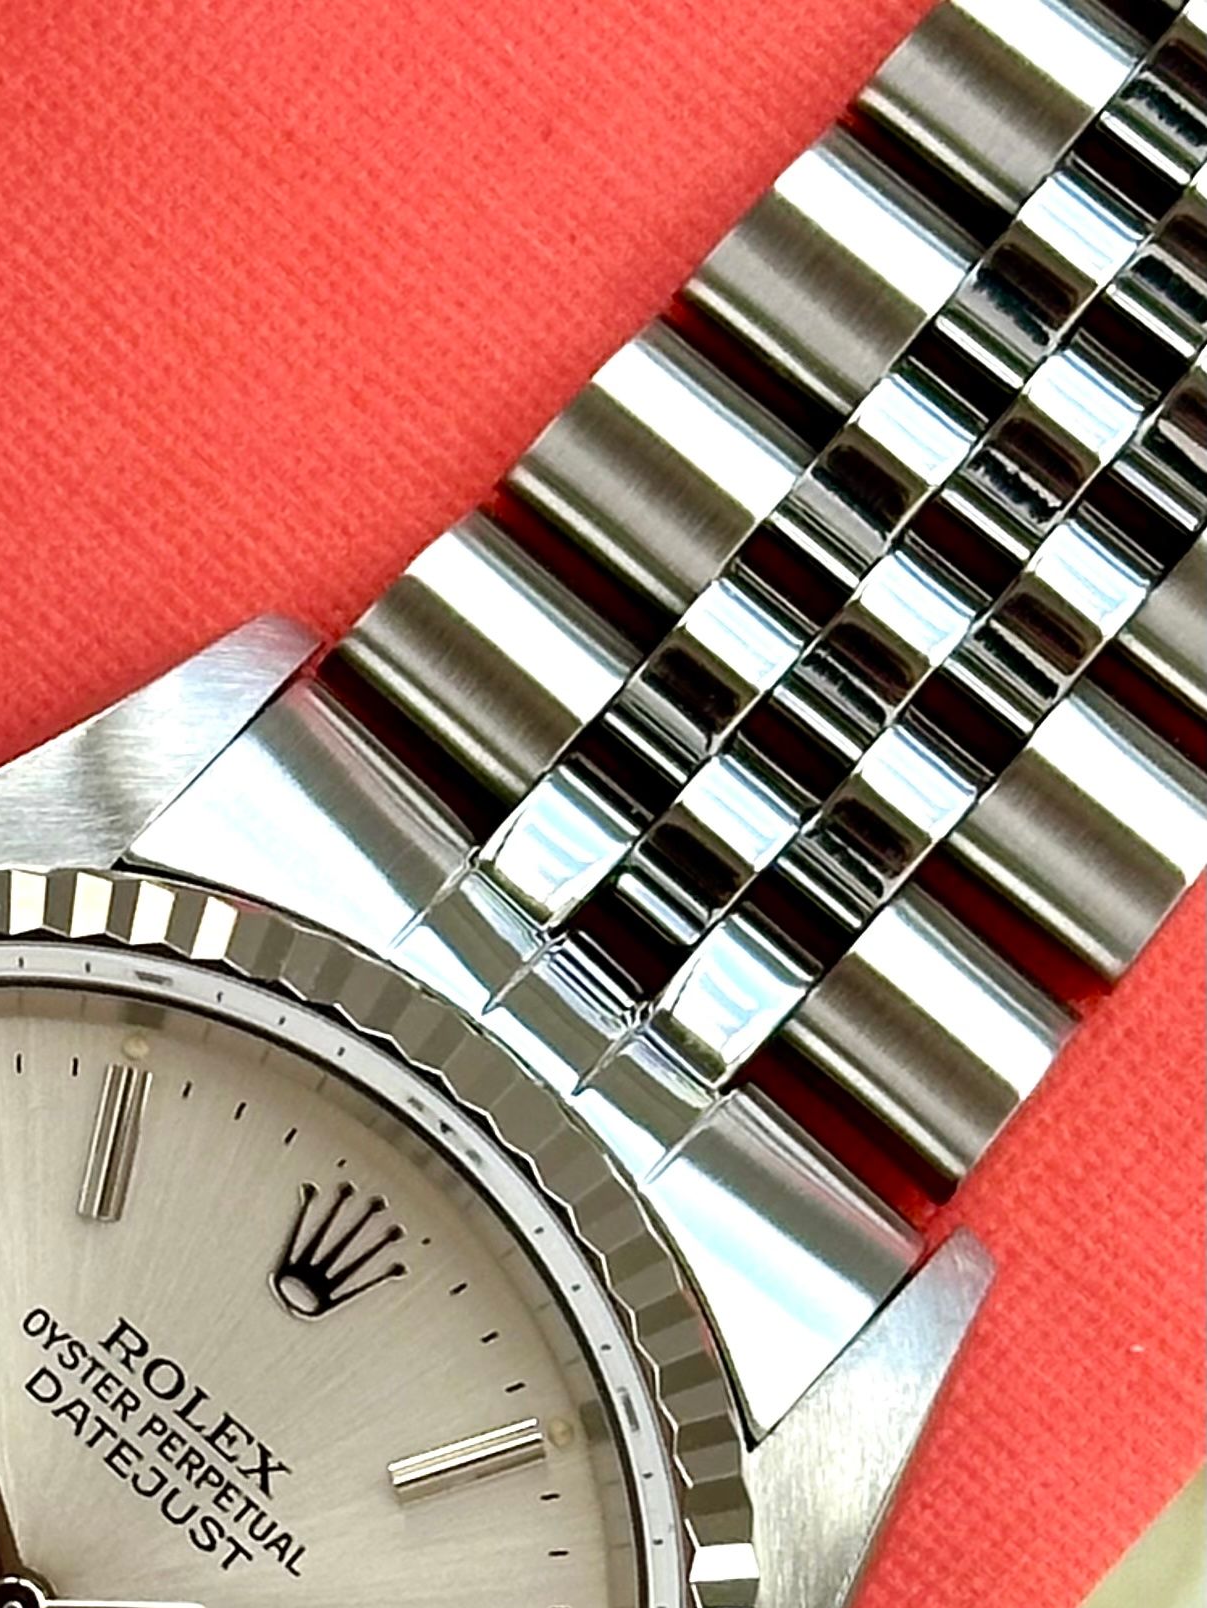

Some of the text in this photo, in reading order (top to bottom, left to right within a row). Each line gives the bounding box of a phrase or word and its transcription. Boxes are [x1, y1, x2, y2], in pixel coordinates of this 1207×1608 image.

[22, 1308, 307, 1577] OYSTER PERPETUAL
[24, 1367, 254, 1571] DATEJUST
[98, 1317, 292, 1499] ROLEX
